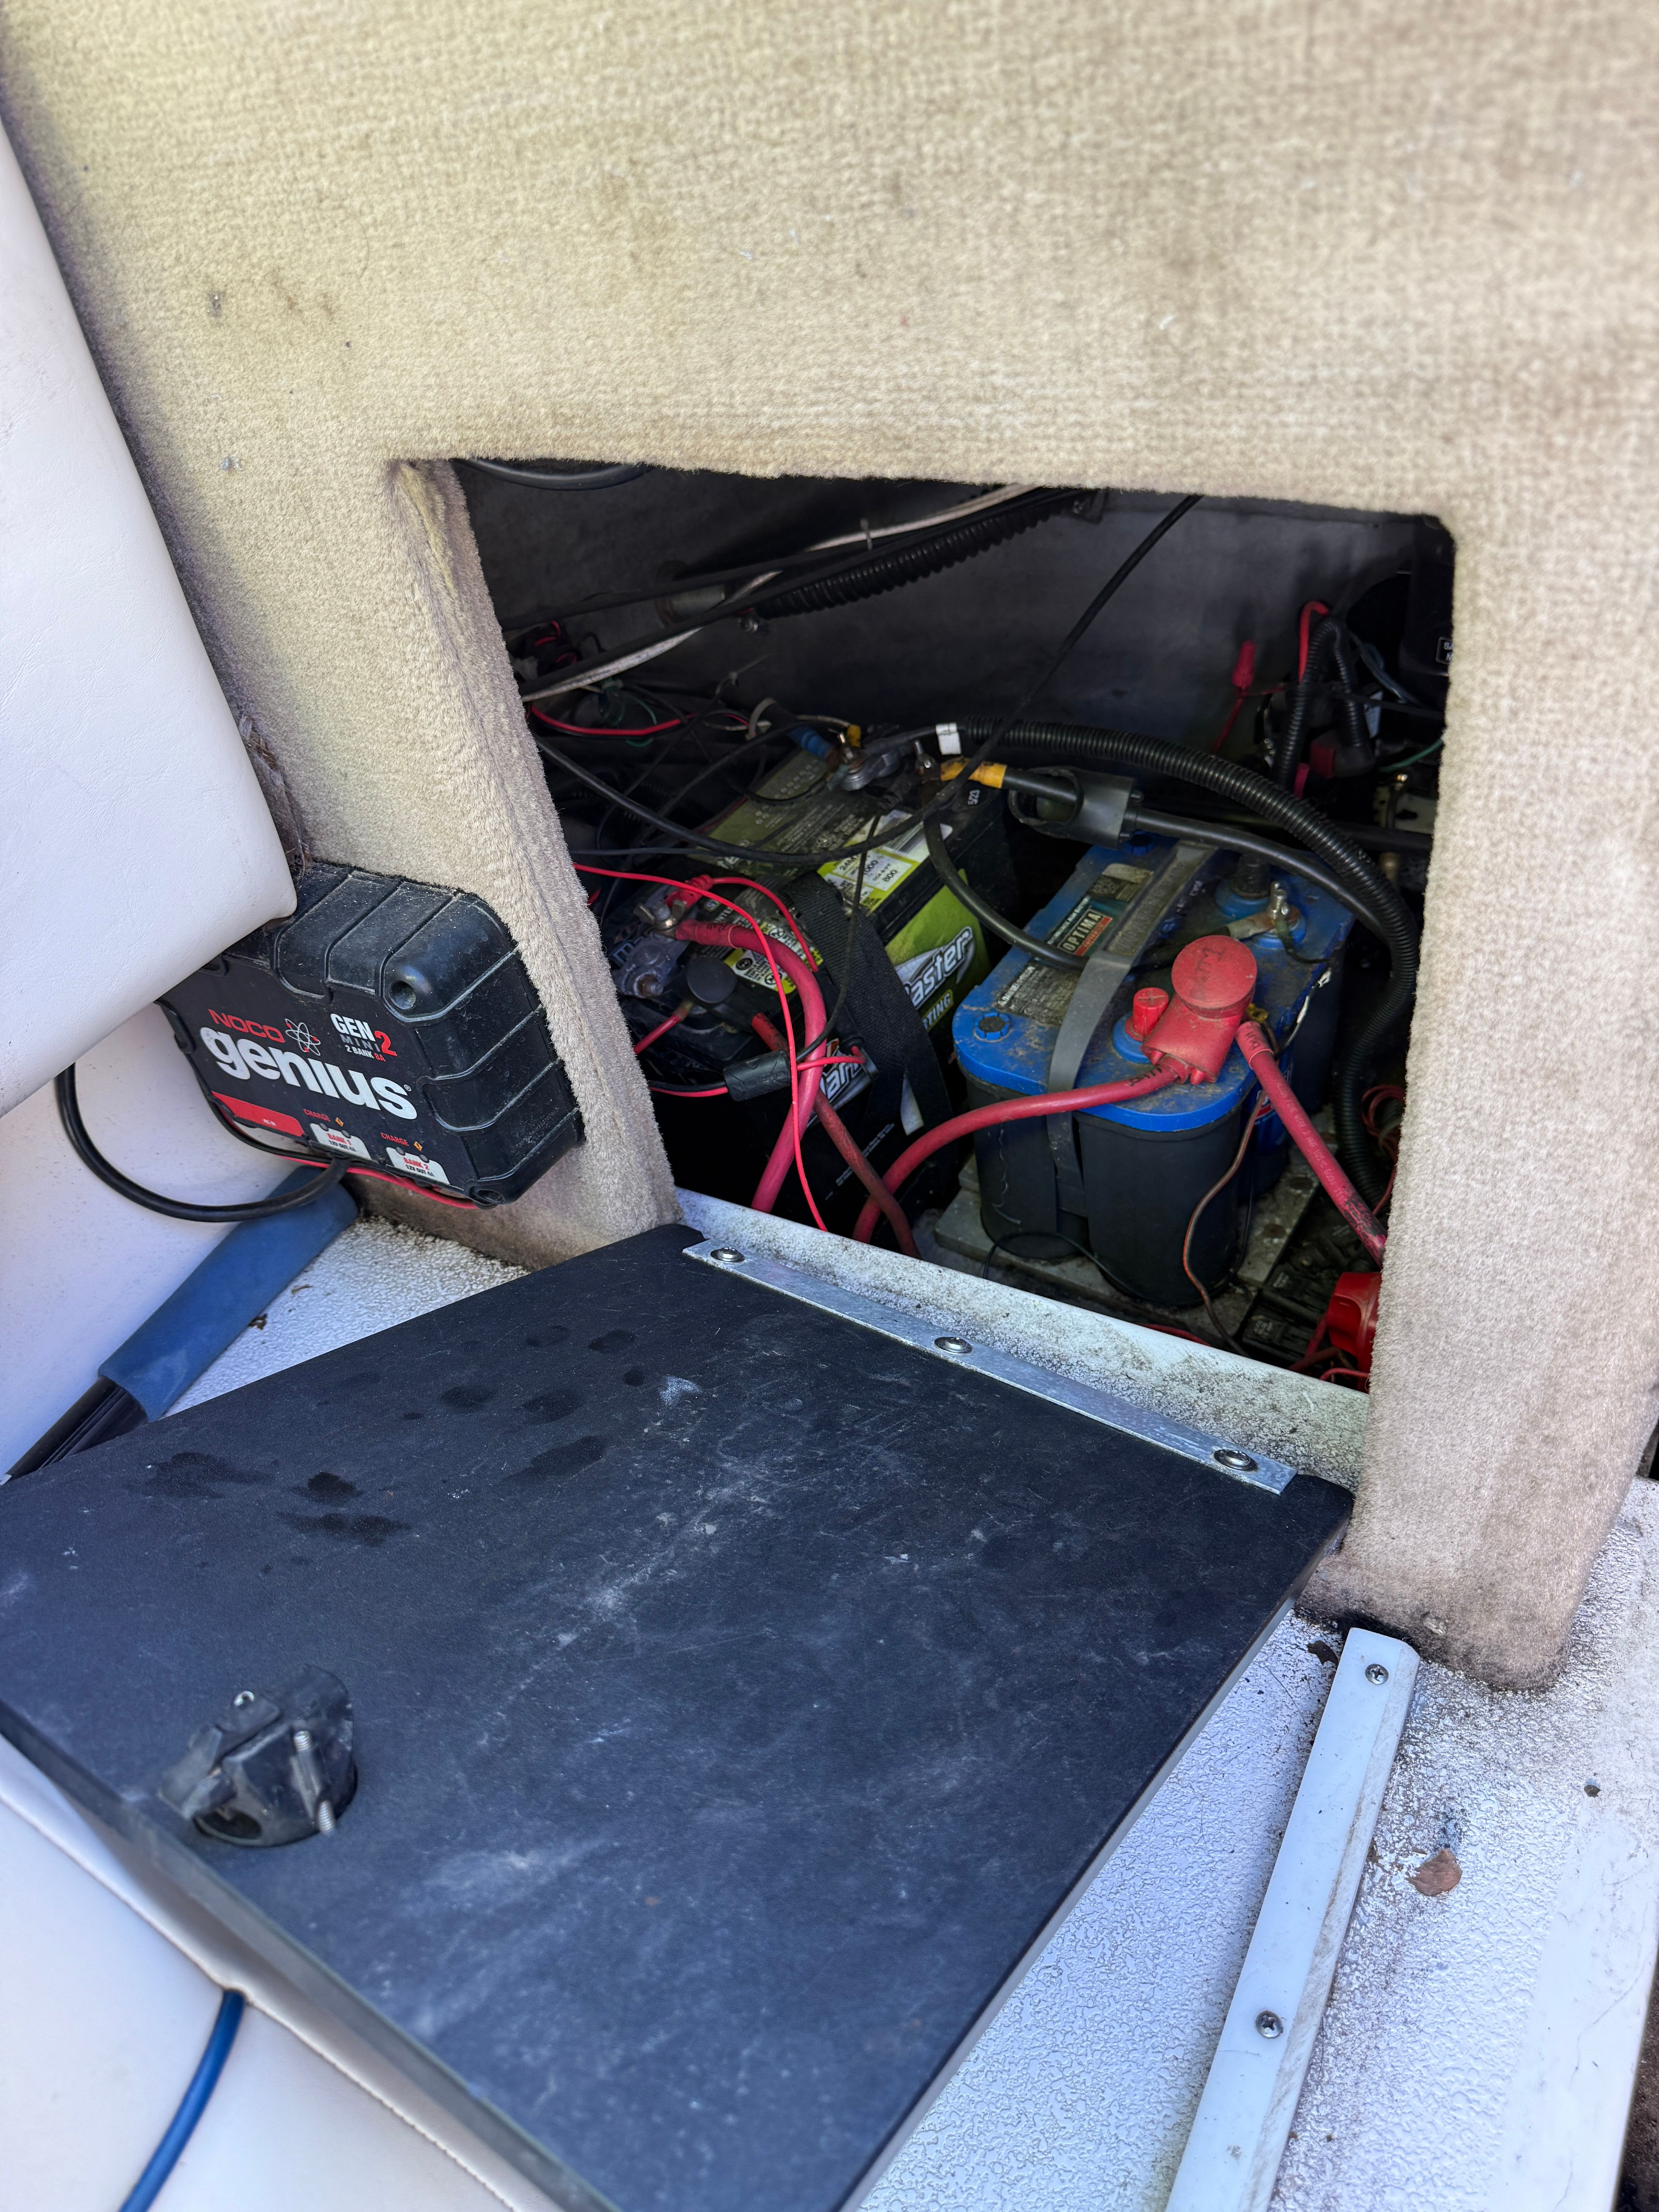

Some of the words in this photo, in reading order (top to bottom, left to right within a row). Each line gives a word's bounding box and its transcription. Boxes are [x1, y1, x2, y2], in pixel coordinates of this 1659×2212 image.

[882, 869, 898, 883] 800
[1062, 912, 1103, 951] OPTIMA
[904, 930, 970, 1007] aster
[208, 1009, 285, 1043] NOCO
[330, 1013, 376, 1042] GEN
[374, 1030, 397, 1057] 2
[340, 1034, 381, 1052] MINI
[345, 1044, 352, 1053] 2
[351, 1046, 375, 1059] BANK
[374, 1052, 386, 1062] 8A
[302, 1108, 331, 1122] CHARGE
[327, 1133, 346, 1144] BANK
[380, 1132, 409, 1146] CHARGE
[403, 1157, 423, 1168] BANK
